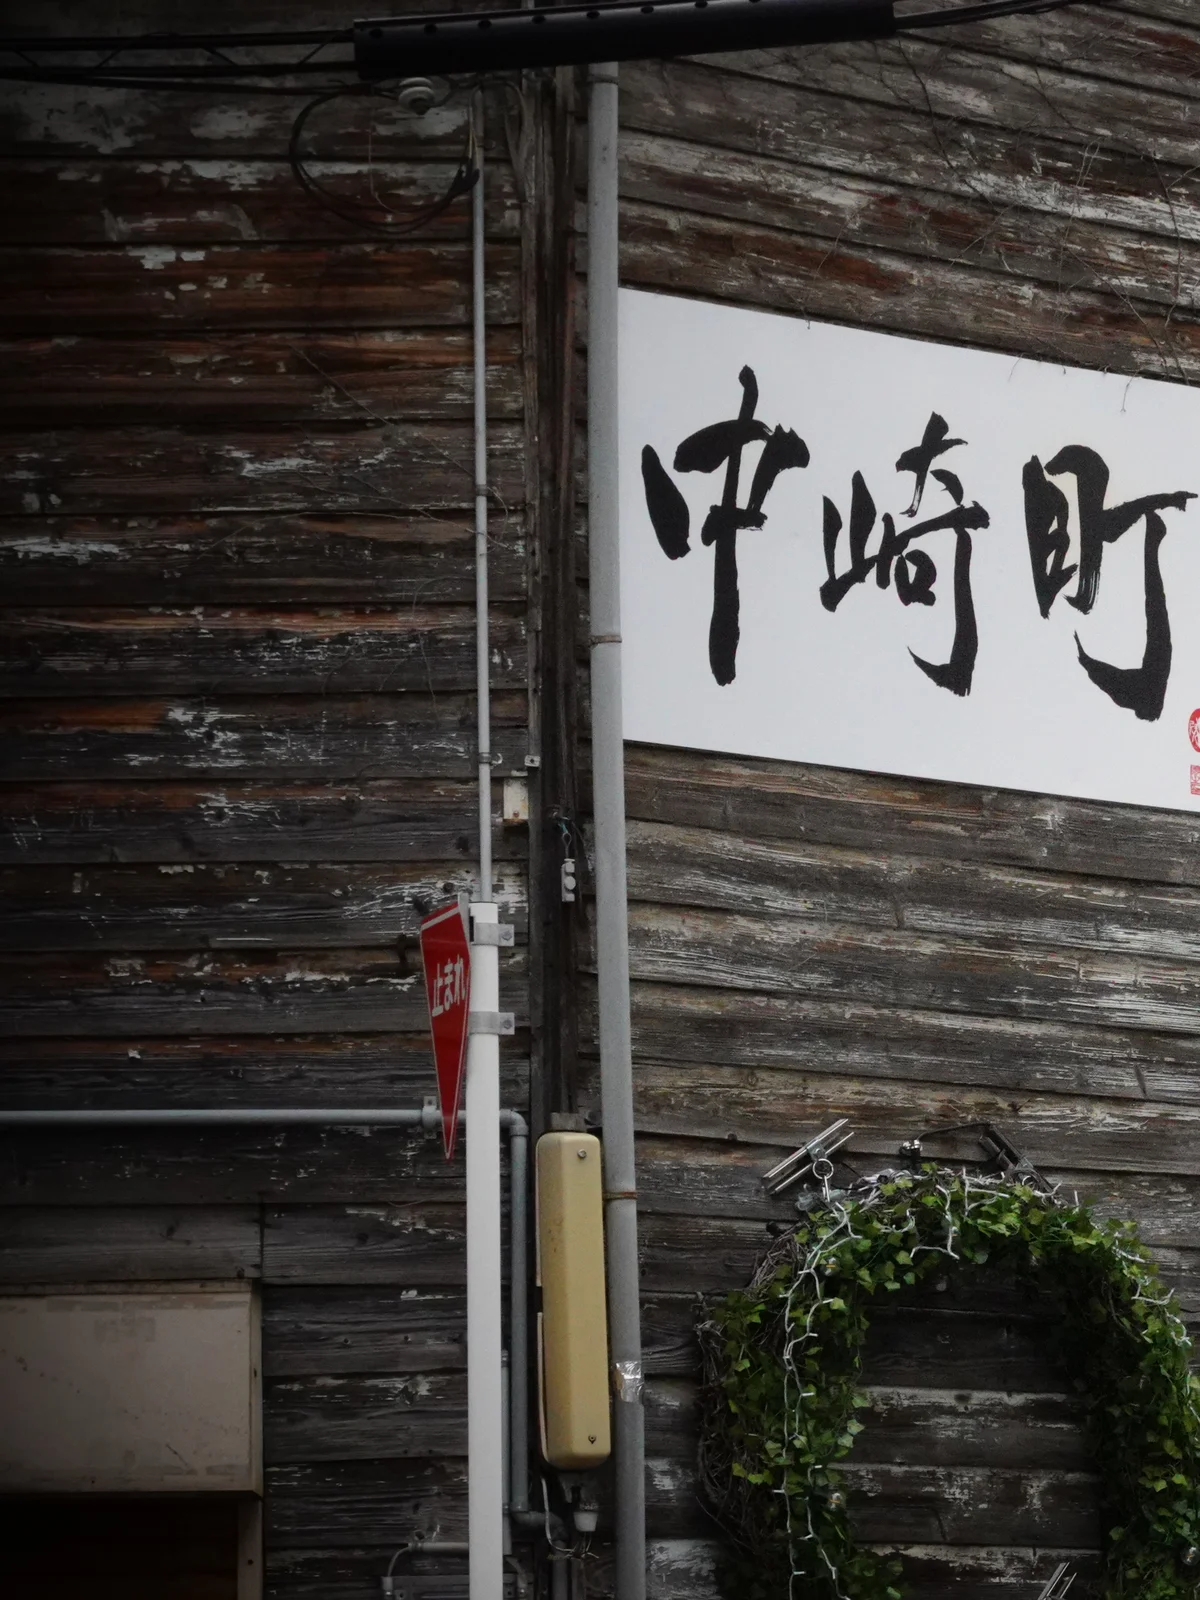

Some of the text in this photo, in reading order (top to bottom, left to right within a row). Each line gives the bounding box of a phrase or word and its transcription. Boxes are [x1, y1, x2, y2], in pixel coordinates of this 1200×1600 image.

[641, 365, 1198, 722] 中崎町
[432, 953, 468, 1017] 止まれ
